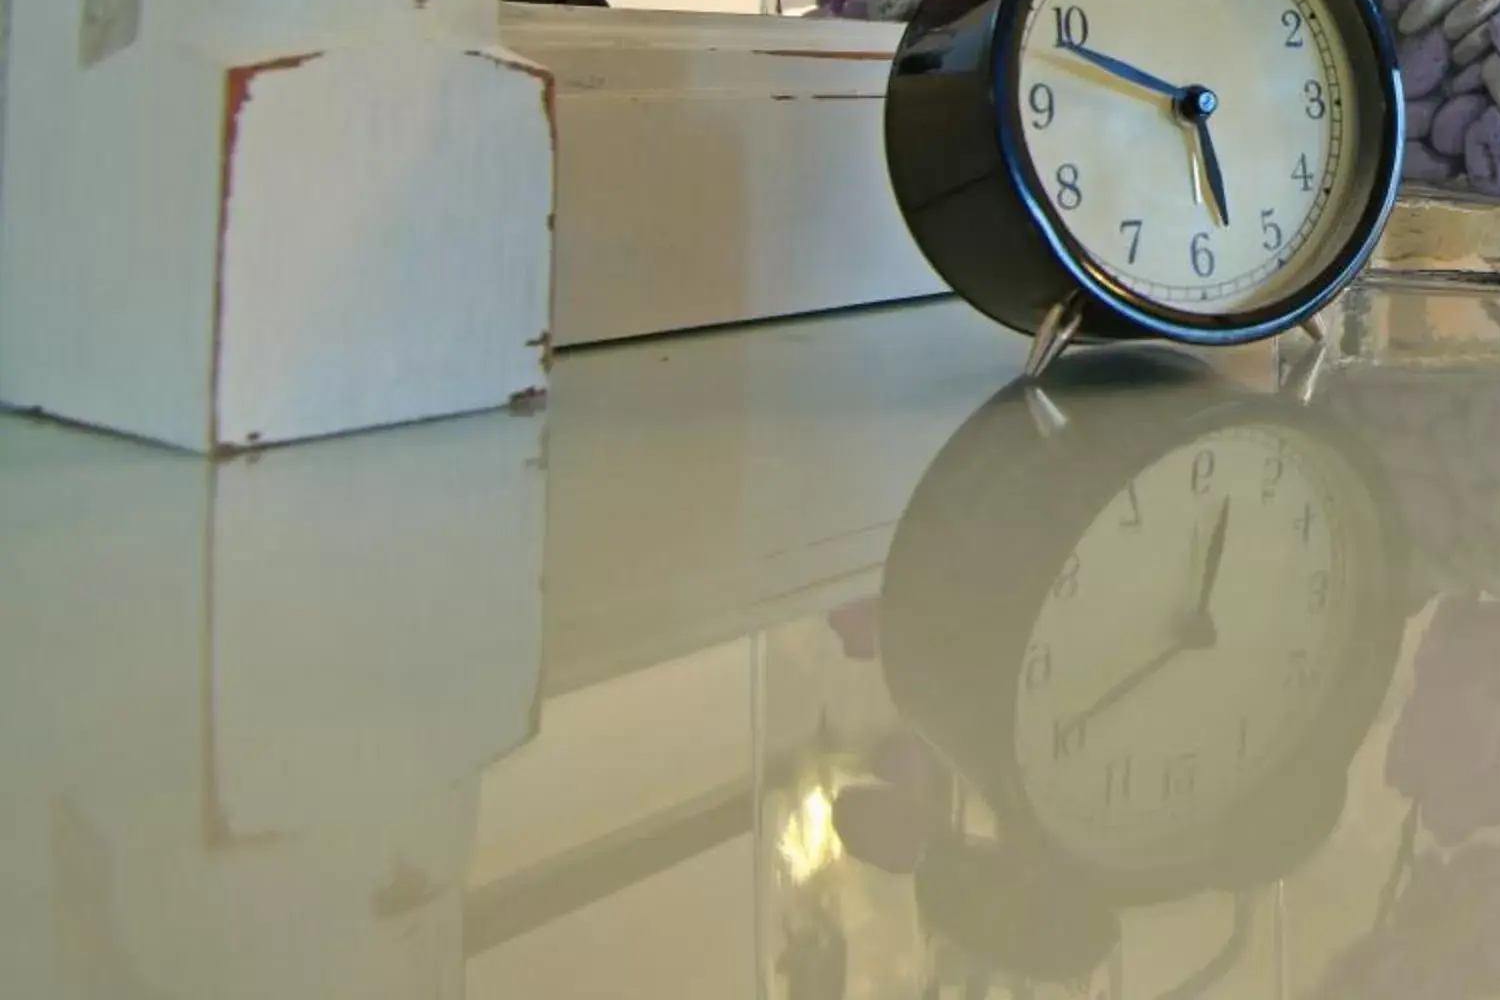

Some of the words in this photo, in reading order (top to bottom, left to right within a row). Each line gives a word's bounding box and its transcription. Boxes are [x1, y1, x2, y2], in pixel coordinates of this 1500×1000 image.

[1052, 6, 1088, 48] 10
[1280, 10, 1303, 47] 2
[1028, 83, 1054, 129] 9
[1303, 81, 1325, 119] 3
[1056, 164, 1082, 210] 8
[1290, 153, 1314, 191] 4
[1119, 220, 1144, 264] 7
[1260, 209, 1283, 250] 5
[1190, 232, 1215, 277] 6
